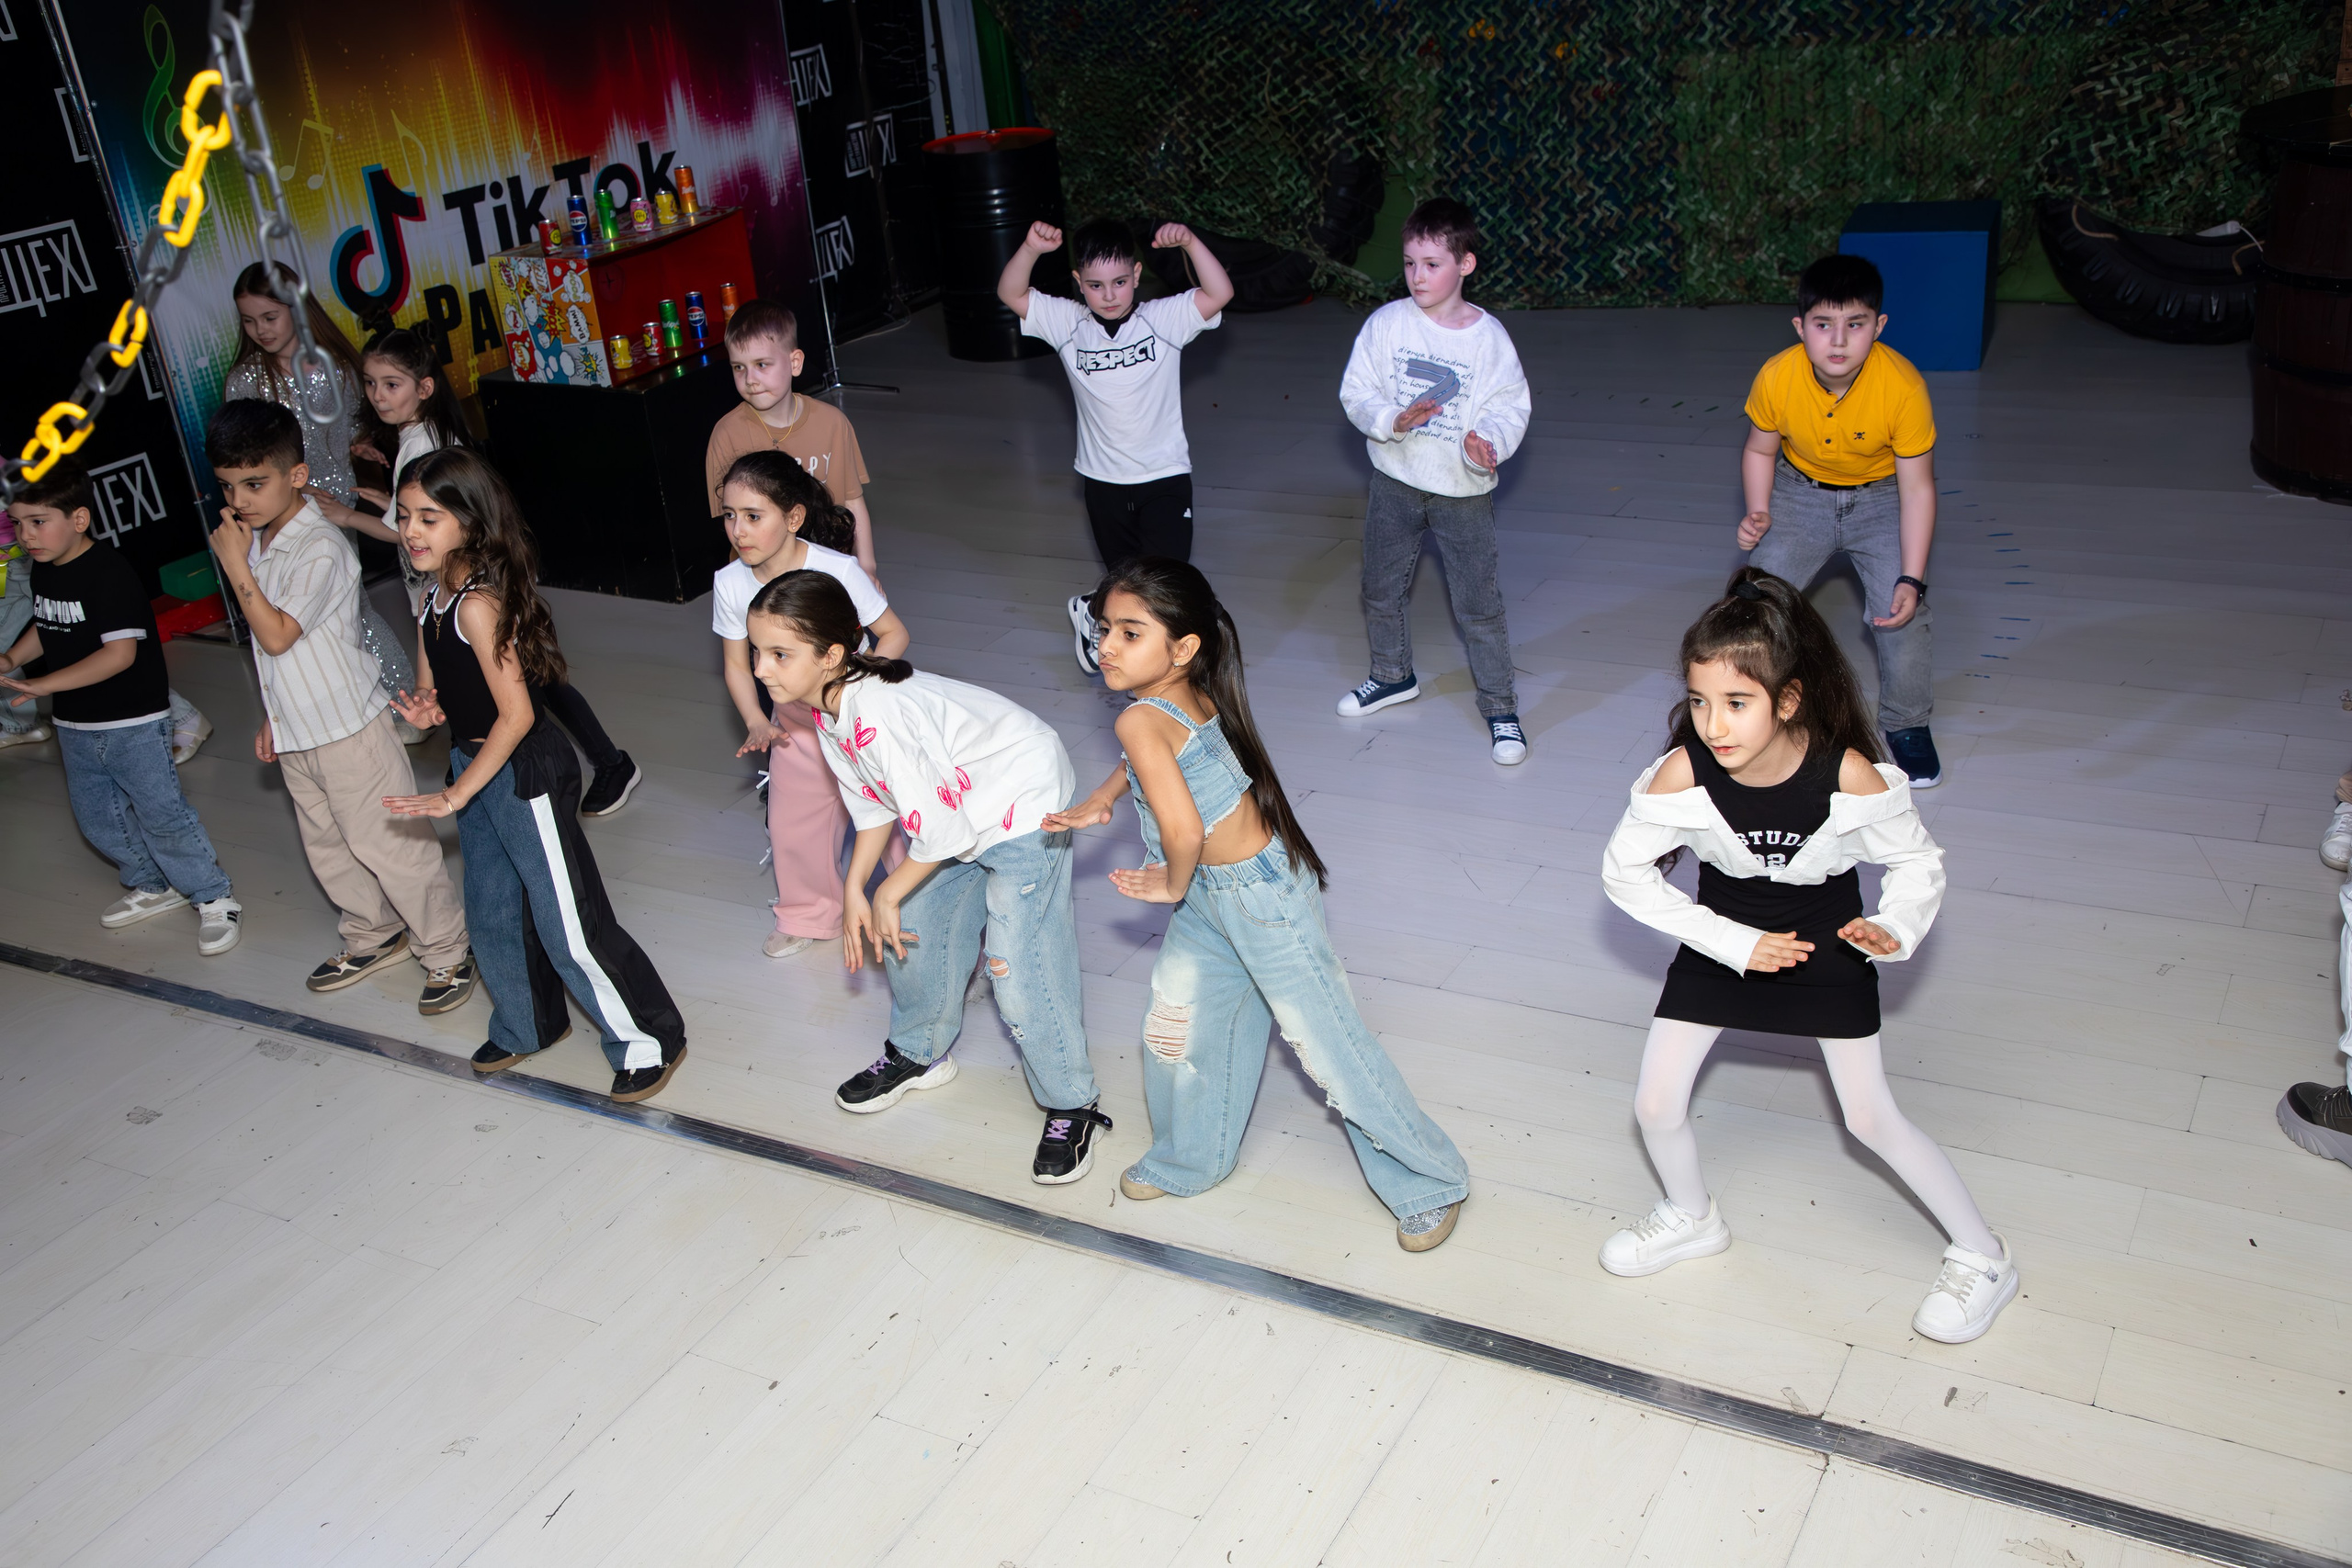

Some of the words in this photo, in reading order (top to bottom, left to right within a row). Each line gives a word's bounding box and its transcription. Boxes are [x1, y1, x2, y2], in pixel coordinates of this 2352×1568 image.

[442, 141, 679, 266] TikTok
[0, 232, 94, 319] ЦЕХ
[1077, 335, 1155, 375] RESPECT
